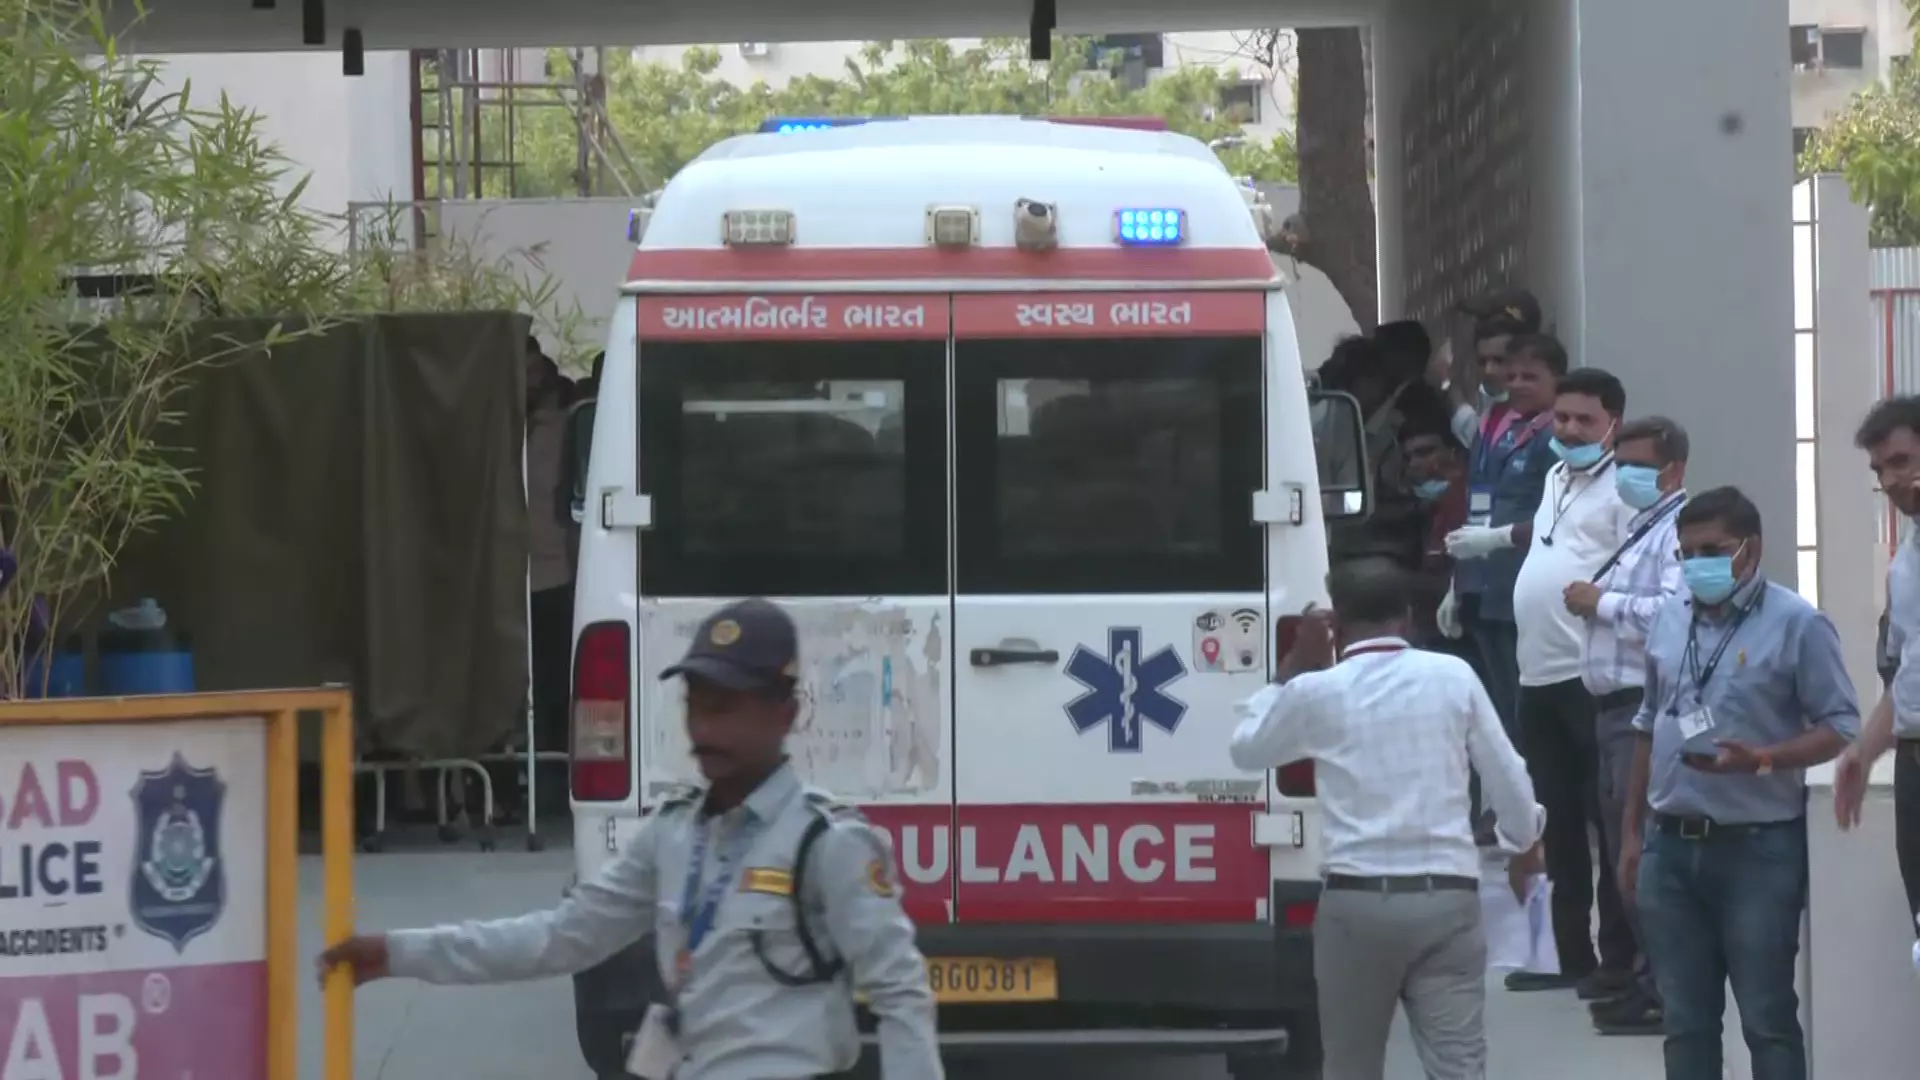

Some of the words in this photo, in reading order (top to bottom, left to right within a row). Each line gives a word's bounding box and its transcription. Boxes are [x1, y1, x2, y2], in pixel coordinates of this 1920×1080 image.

[843, 303, 924, 329] ભારત
[1015, 302, 1095, 327] સ્વસ્થ
[1109, 301, 1192, 326] ભારત
[0, 759, 102, 830] AD
